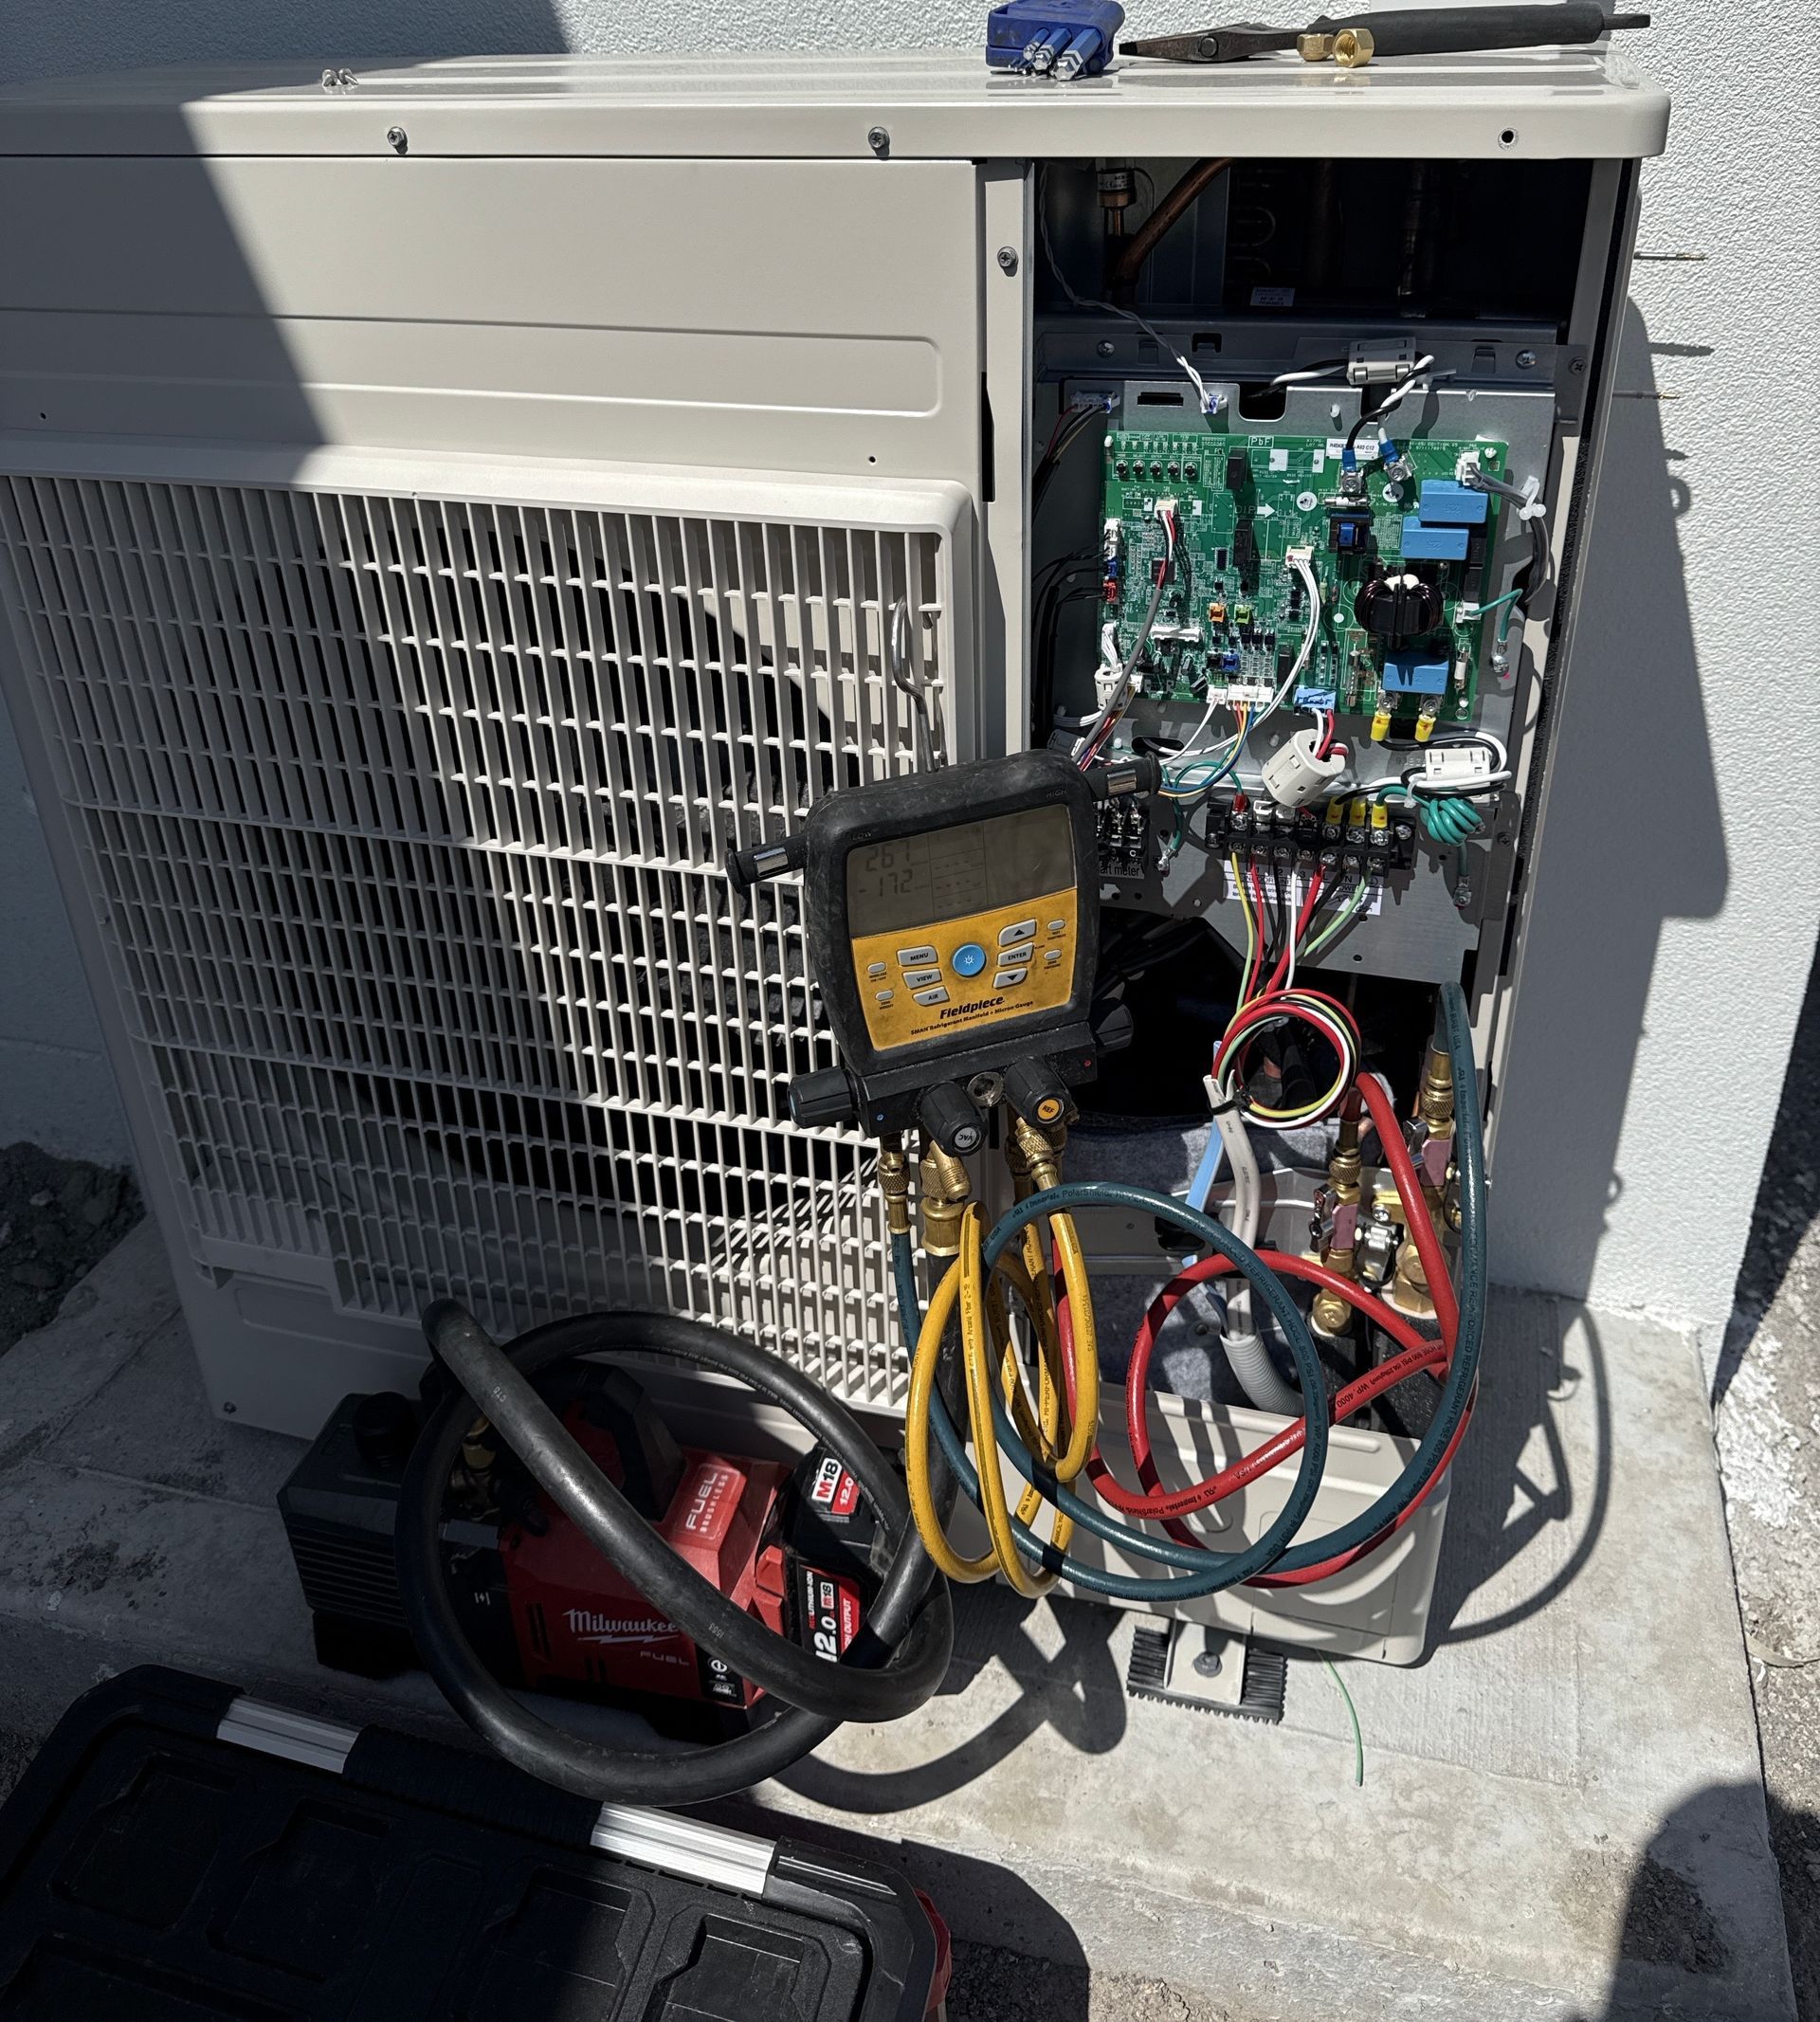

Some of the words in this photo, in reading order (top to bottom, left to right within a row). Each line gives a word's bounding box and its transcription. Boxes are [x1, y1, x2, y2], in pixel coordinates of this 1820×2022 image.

[1251, 437, 1270, 446] PbF
[1114, 865, 1139, 877] meter
[1344, 875, 1352, 883] N
[910, 952, 929, 961] MENU
[1008, 952, 1027, 960] ENTER
[929, 1018, 962, 1030] Refrigerant
[963, 1011, 989, 1022] Manifold
[994, 1006, 1014, 1014] Micron
[1014, 1000, 1033, 1009] Gauge
[940, 995, 1004, 1019] Fieldpiece
[1042, 1104, 1054, 1114] REF
[1244, 1260, 1291, 1322] REFRIGERANT
[1286, 1319, 1303, 1344] HOSE
[1305, 1360, 1314, 1378] PSI
[1450, 1354, 1473, 1417] REFRIGERANT
[1335, 1391, 1355, 1408] 4000
[815, 1460, 840, 1501] M18
[839, 1476, 854, 1506] 12.0
[685, 1472, 719, 1531] FUEL
[700, 1472, 729, 1534] BRUSHLESS
[822, 1584, 831, 1607] M18
[562, 1608, 679, 1633] Milwaukee
[843, 1597, 852, 1634] OUTPUT
[813, 1615, 838, 1663] 12.0
[640, 1650, 690, 1667] FUEL
